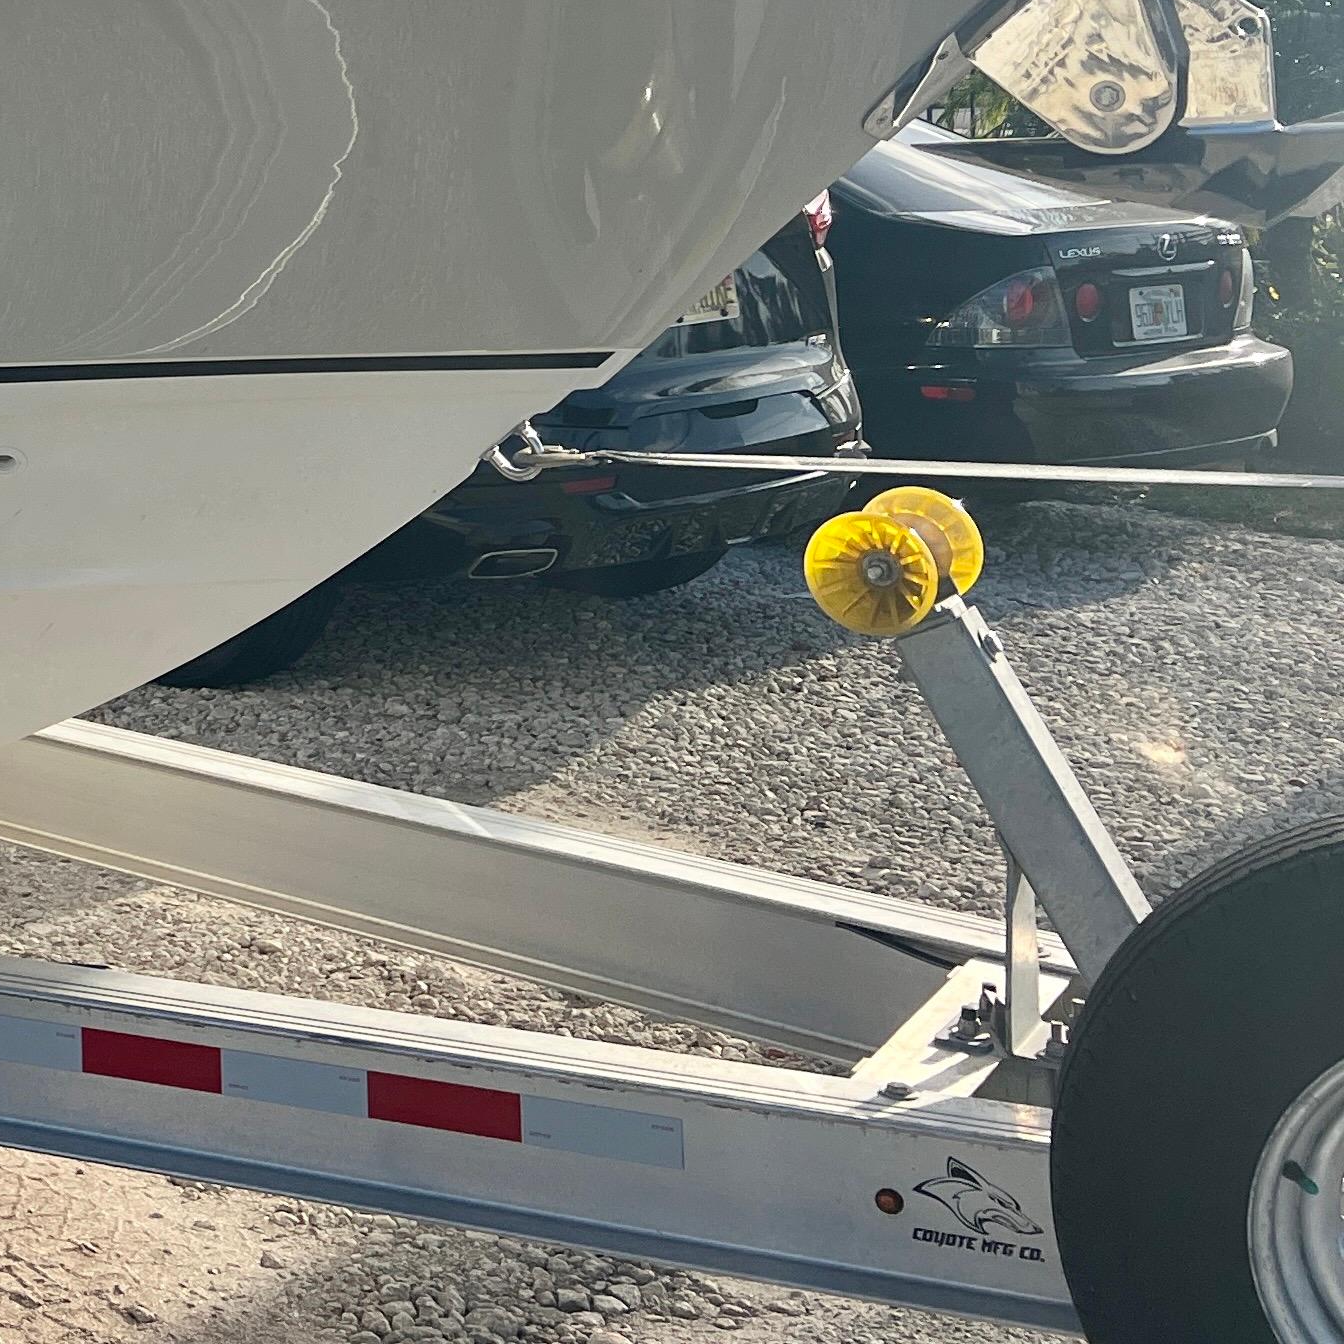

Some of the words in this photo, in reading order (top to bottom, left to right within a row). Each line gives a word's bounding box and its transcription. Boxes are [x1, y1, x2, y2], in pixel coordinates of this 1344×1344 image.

[1058, 246, 1101, 259] LEXUS
[912, 1227, 978, 1250] COYOTE
[981, 1238, 1017, 1257] MFG
[1019, 1246, 1046, 1263] CO.
